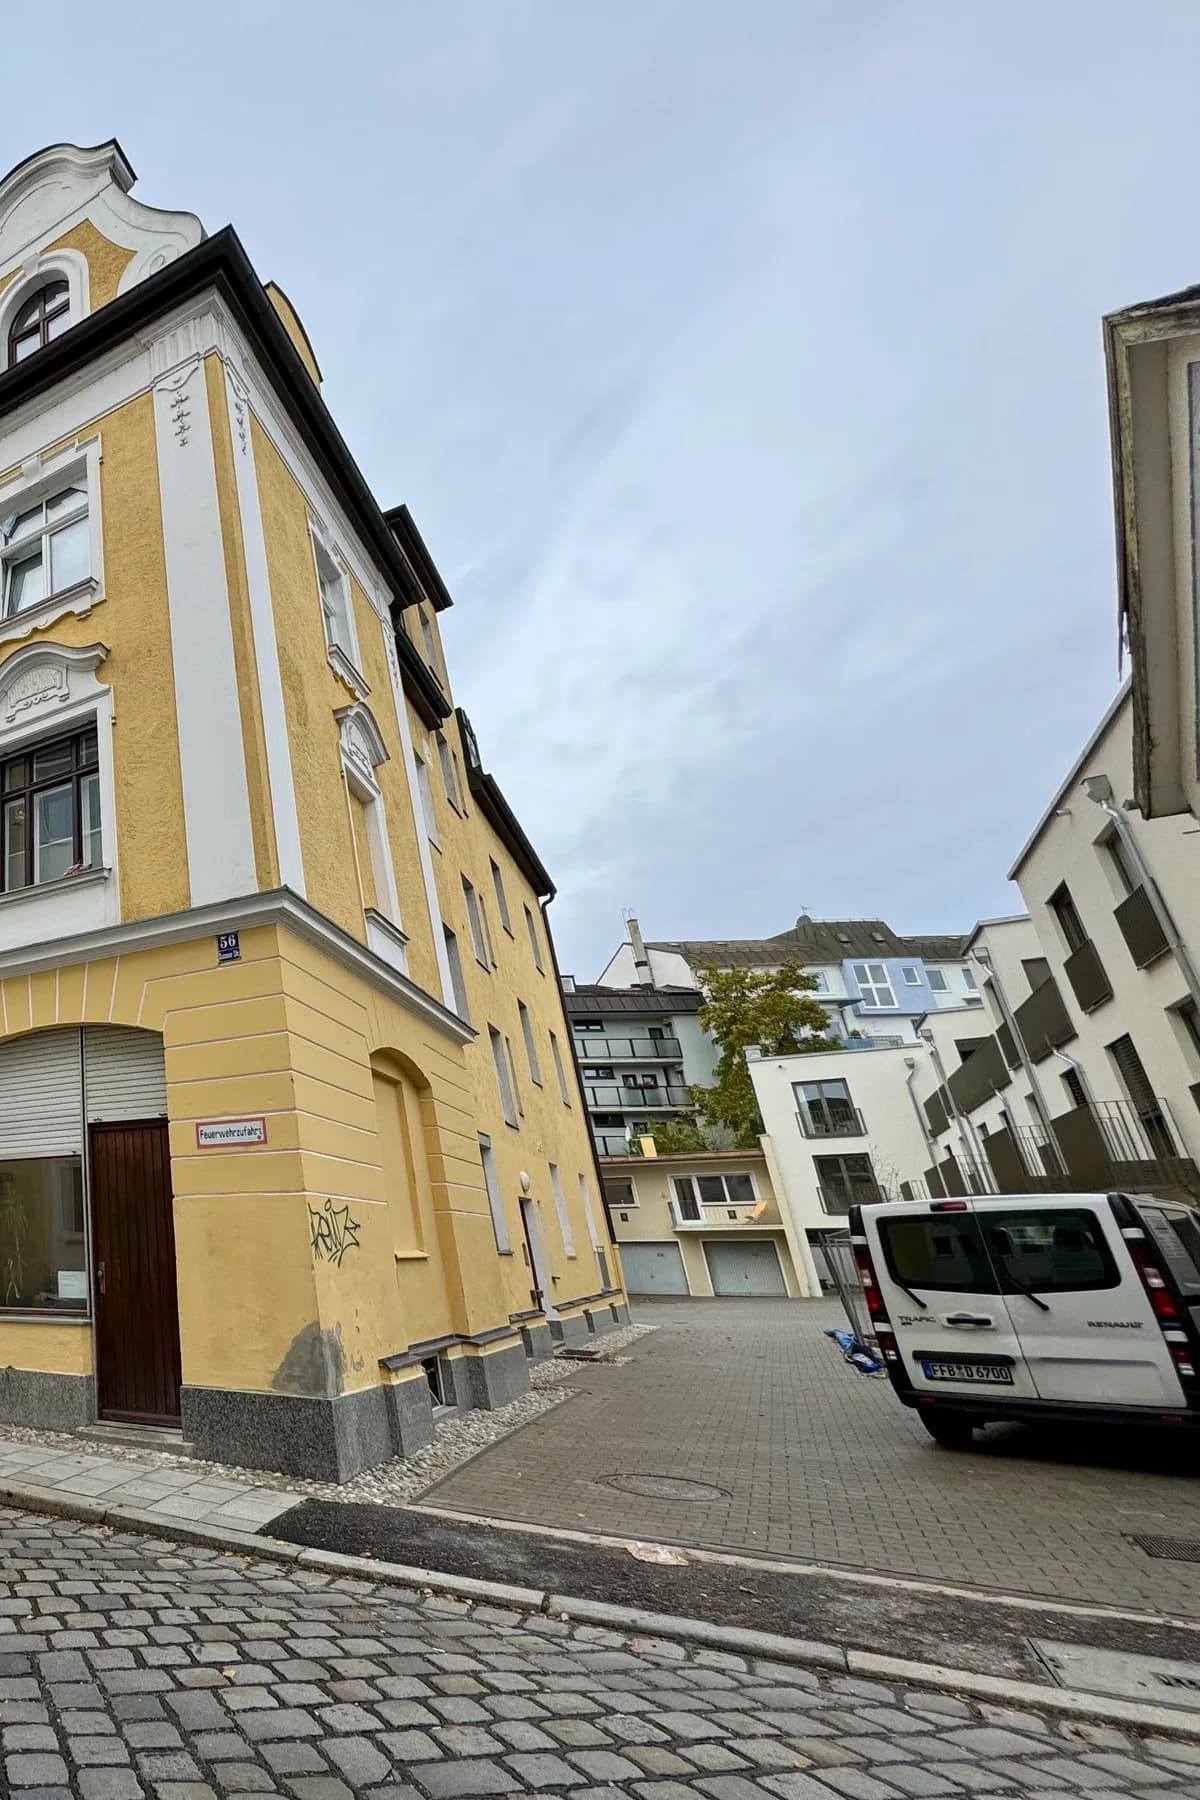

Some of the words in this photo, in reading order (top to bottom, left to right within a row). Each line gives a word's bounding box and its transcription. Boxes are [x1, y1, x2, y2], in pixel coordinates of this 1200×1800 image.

[220, 934, 236, 949] 56
[200, 1126, 262, 1139] Feuerwehrzufahrt
[1087, 1320, 1144, 1328] RENAULT
[931, 1364, 956, 1377] FFB
[963, 1366, 974, 1377] D
[976, 1366, 1009, 1380] 6700
